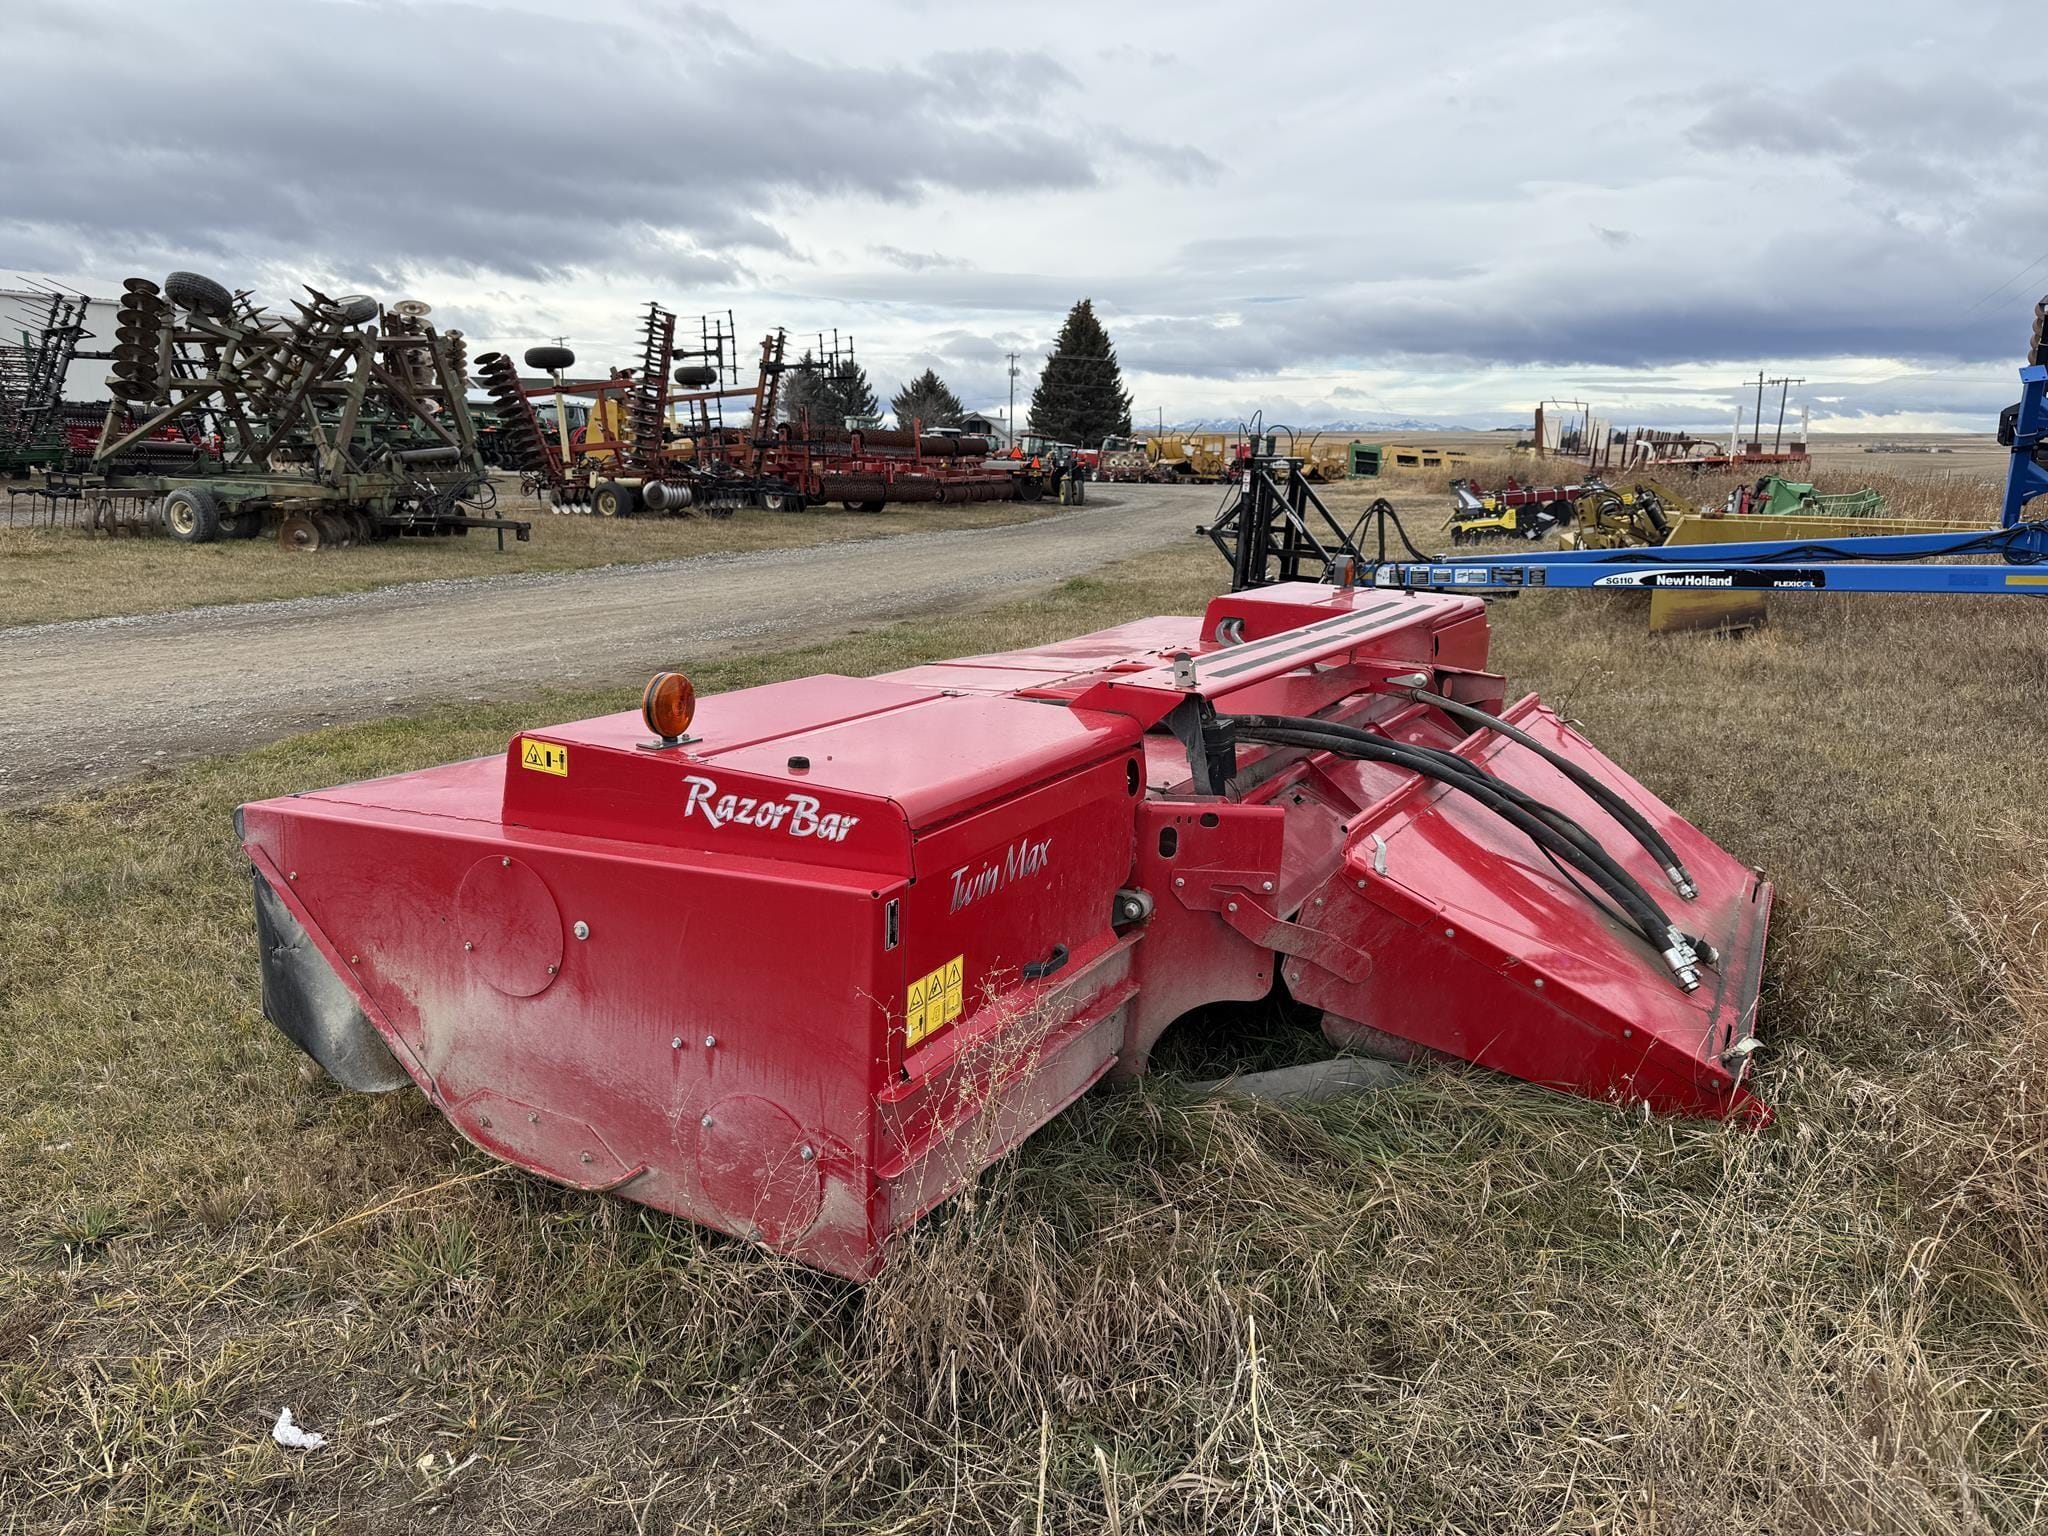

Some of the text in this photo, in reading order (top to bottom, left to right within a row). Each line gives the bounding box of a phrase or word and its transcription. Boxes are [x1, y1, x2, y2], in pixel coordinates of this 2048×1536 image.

[1606, 577, 1634, 585] SG110
[1656, 575, 1733, 586] New Holland
[681, 774, 861, 843] RazorBar
[949, 838, 1052, 915] Twin Max
